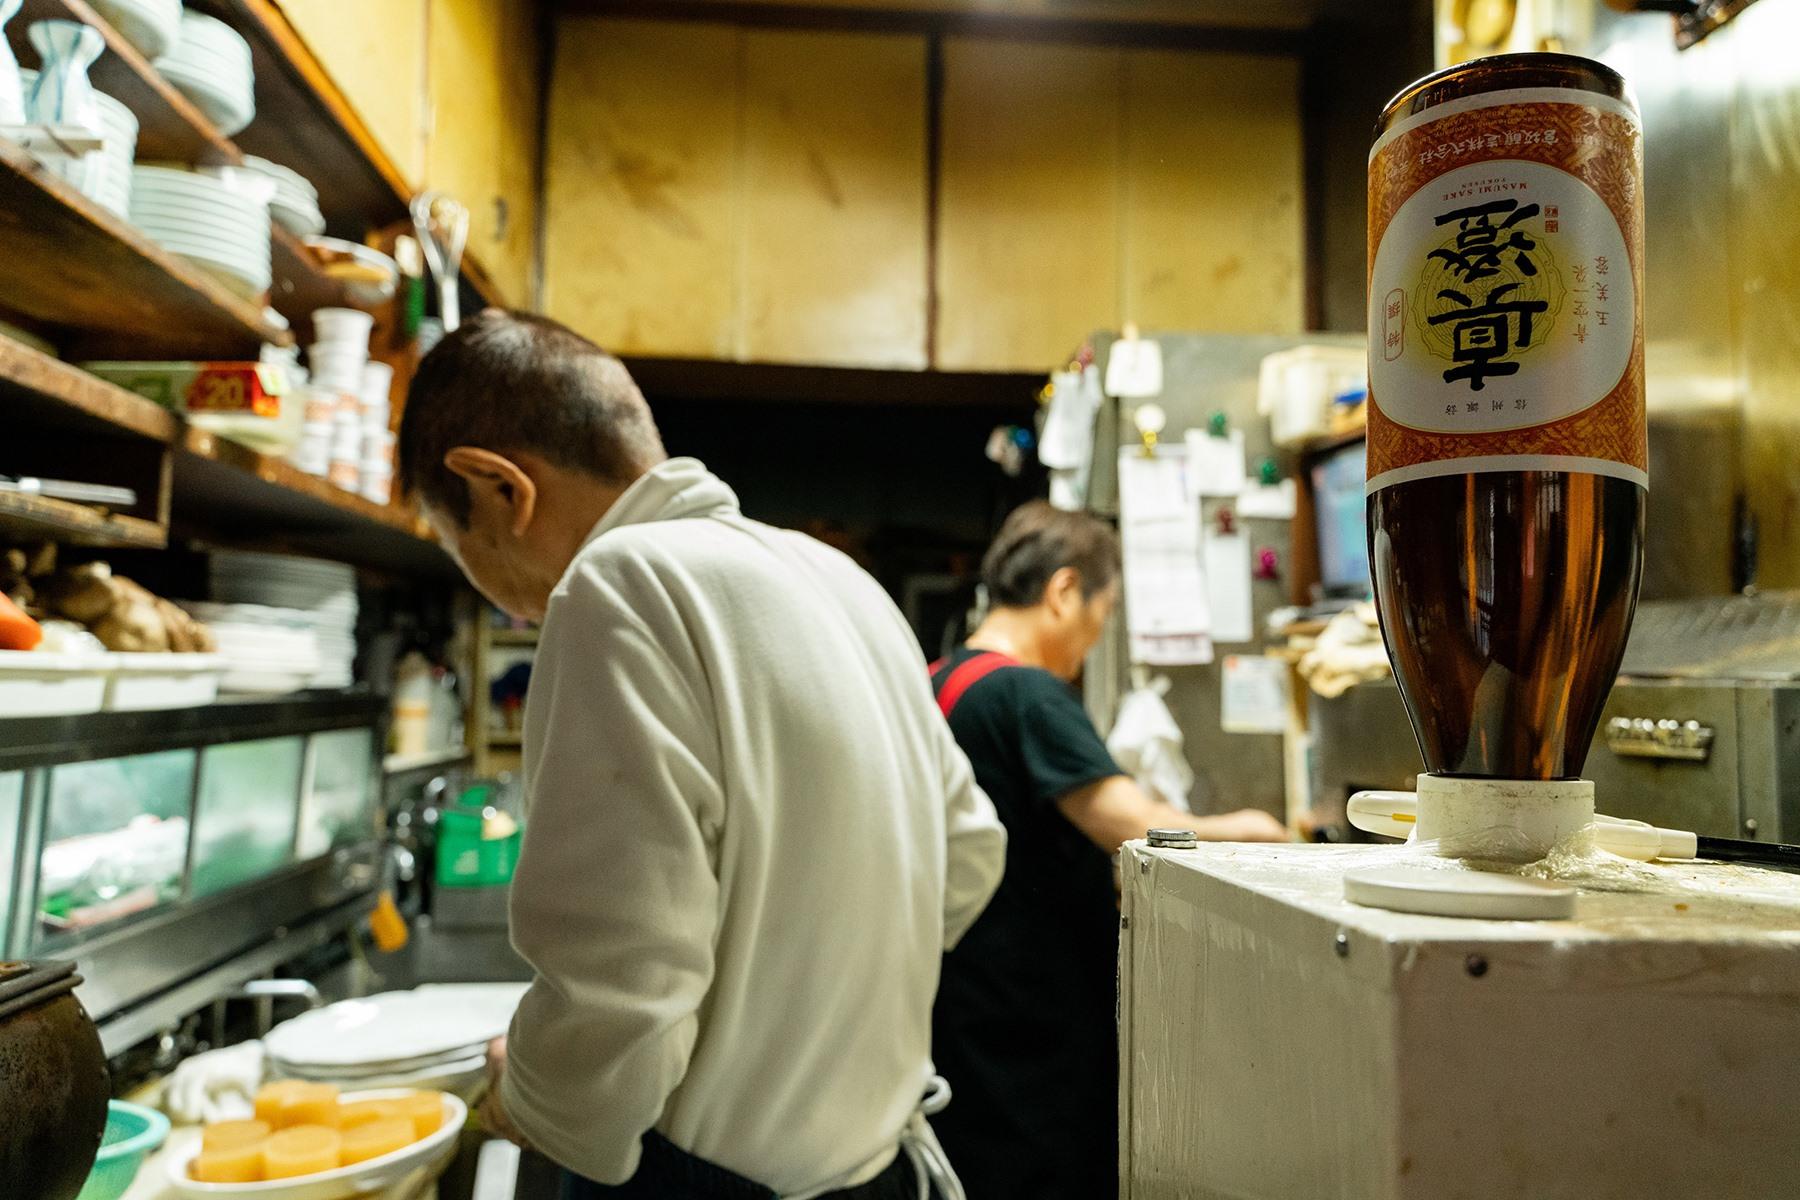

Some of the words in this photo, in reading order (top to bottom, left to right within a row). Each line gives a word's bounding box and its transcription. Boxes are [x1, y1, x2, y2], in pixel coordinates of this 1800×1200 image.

[1461, 177, 1506, 188] TOKUSEN
[1478, 182, 1527, 194] MASUMI
[1442, 189, 1473, 201] SAKE
[207, 376, 244, 407] 20
[1445, 399, 1528, 415] 信州諏訪
